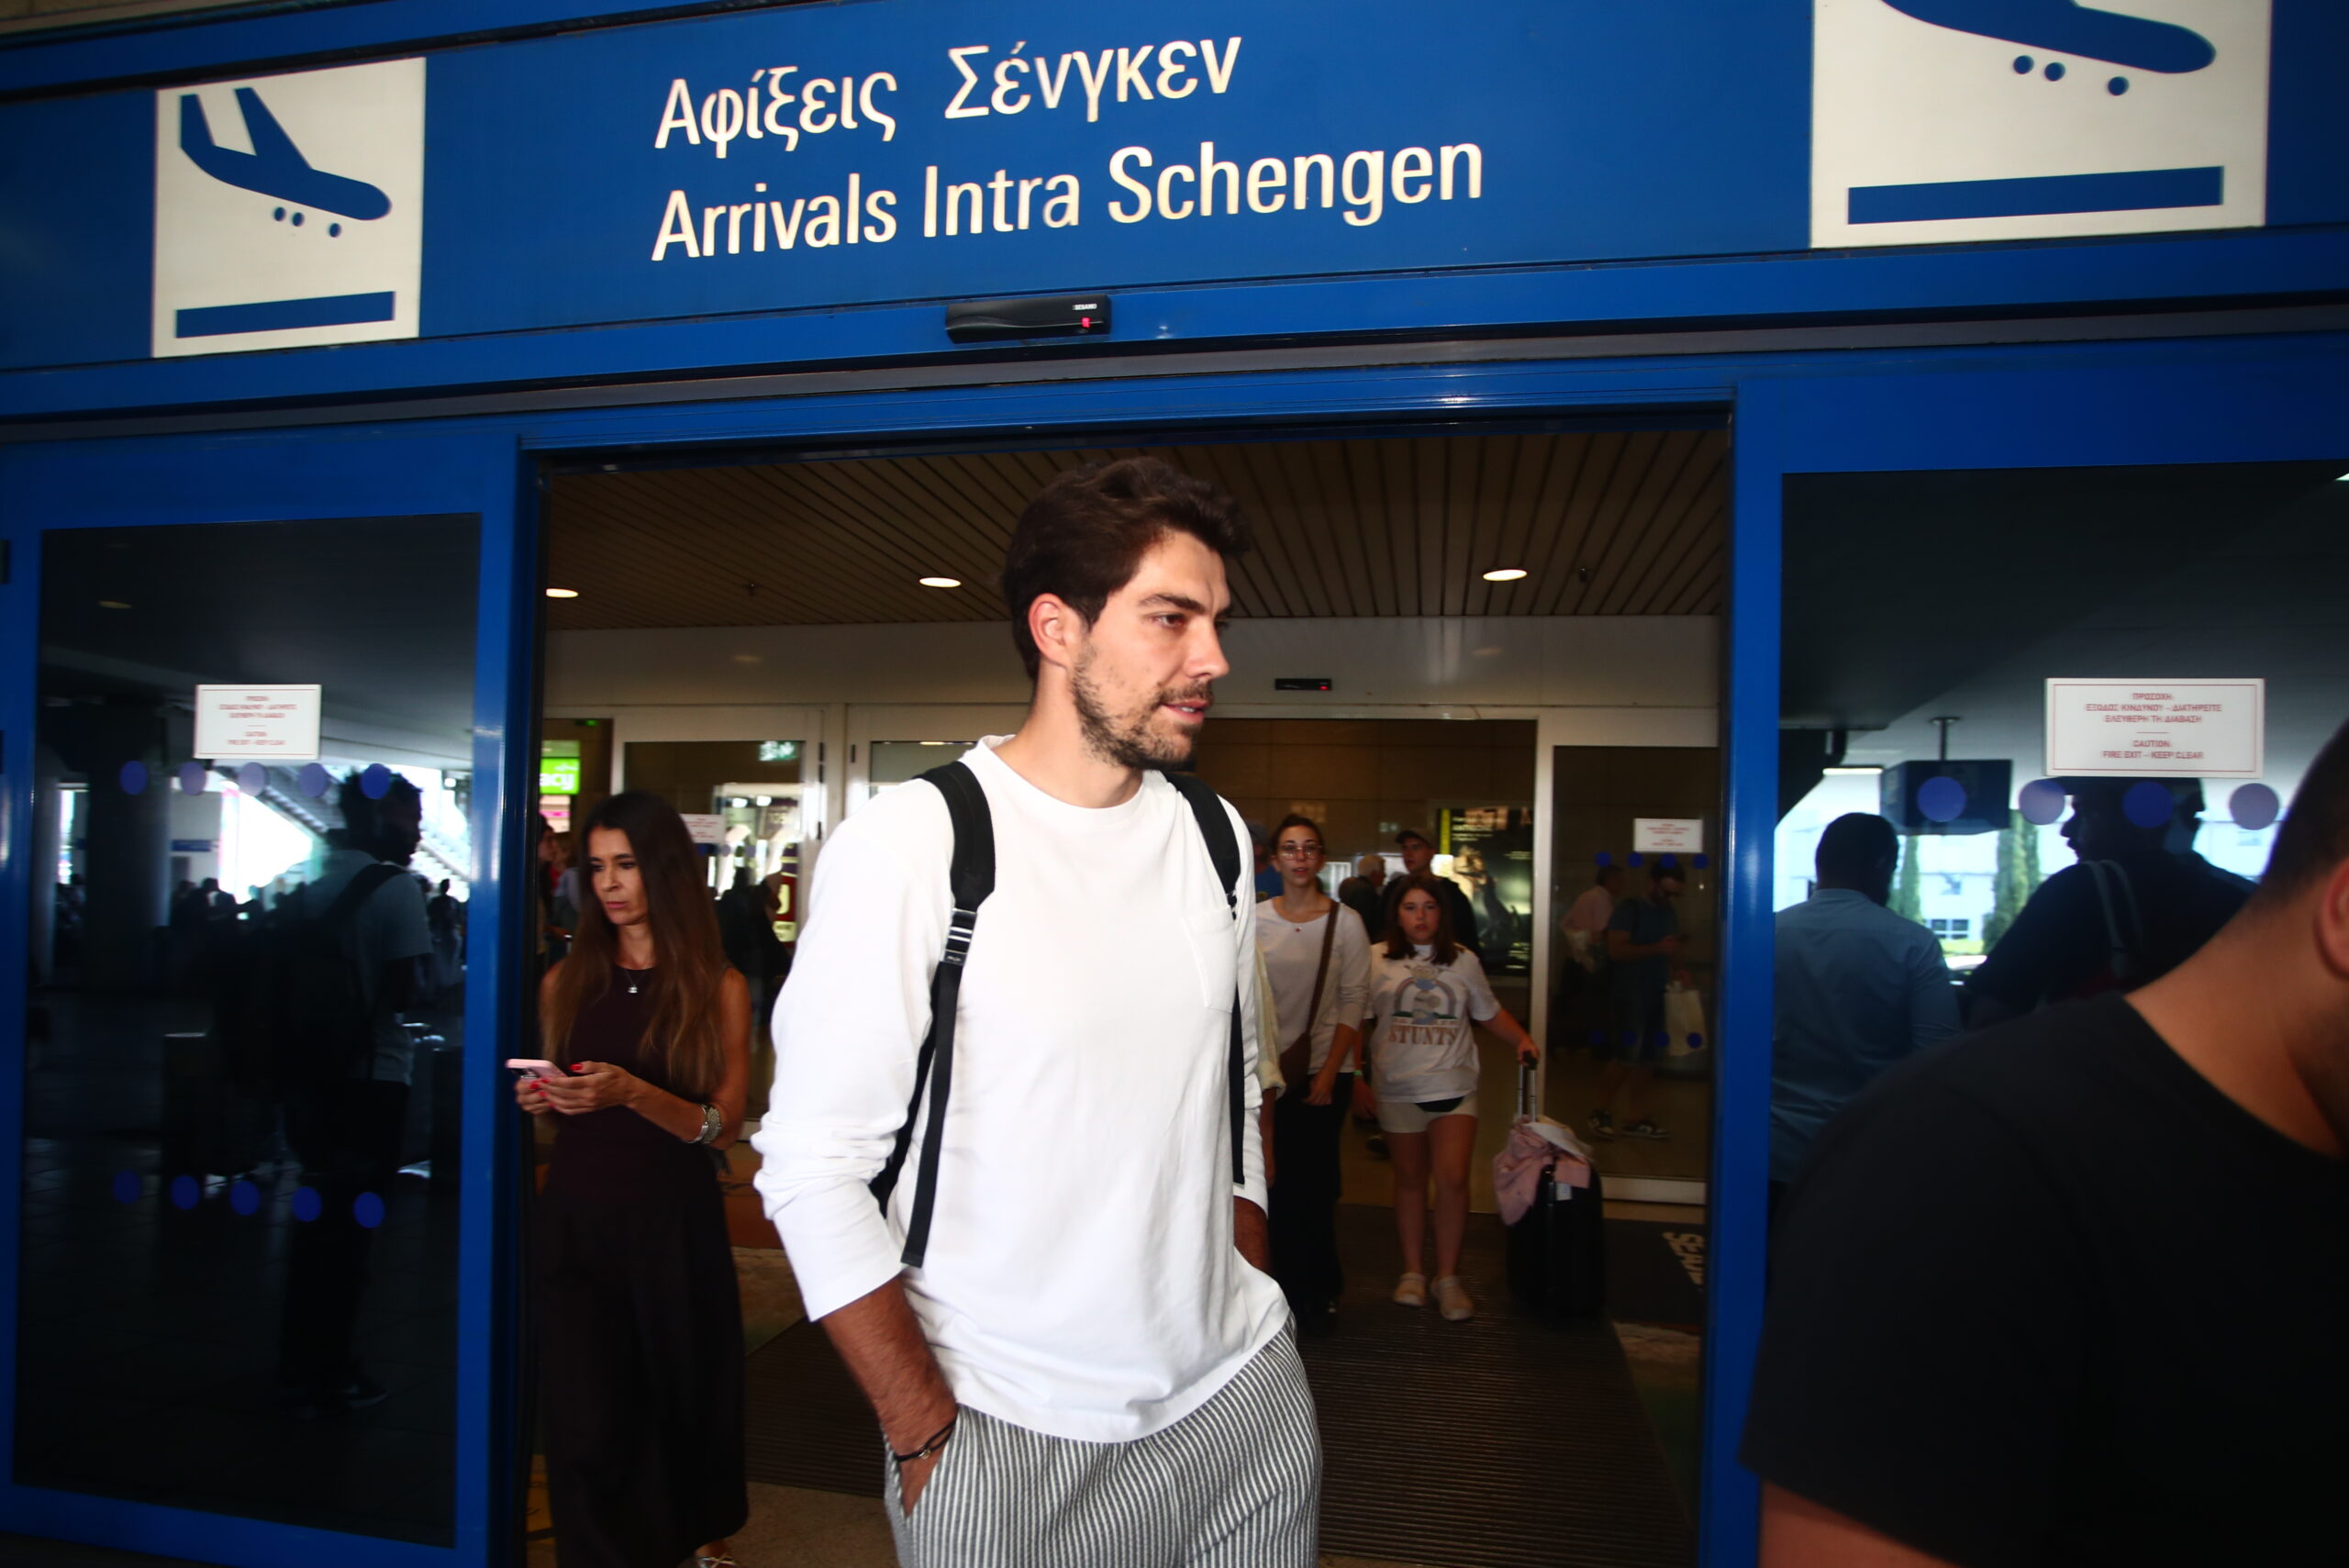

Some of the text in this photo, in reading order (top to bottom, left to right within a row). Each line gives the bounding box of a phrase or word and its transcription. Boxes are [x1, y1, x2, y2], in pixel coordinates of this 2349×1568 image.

[654, 36, 1242, 160] Αφίξεις Σένγκεν
[651, 140, 1483, 261] Arrivals Intra Schengen
[2124, 751, 2142, 759] EXIT
[2151, 751, 2175, 760] KEEP
[2176, 751, 2204, 760] CLEAR
